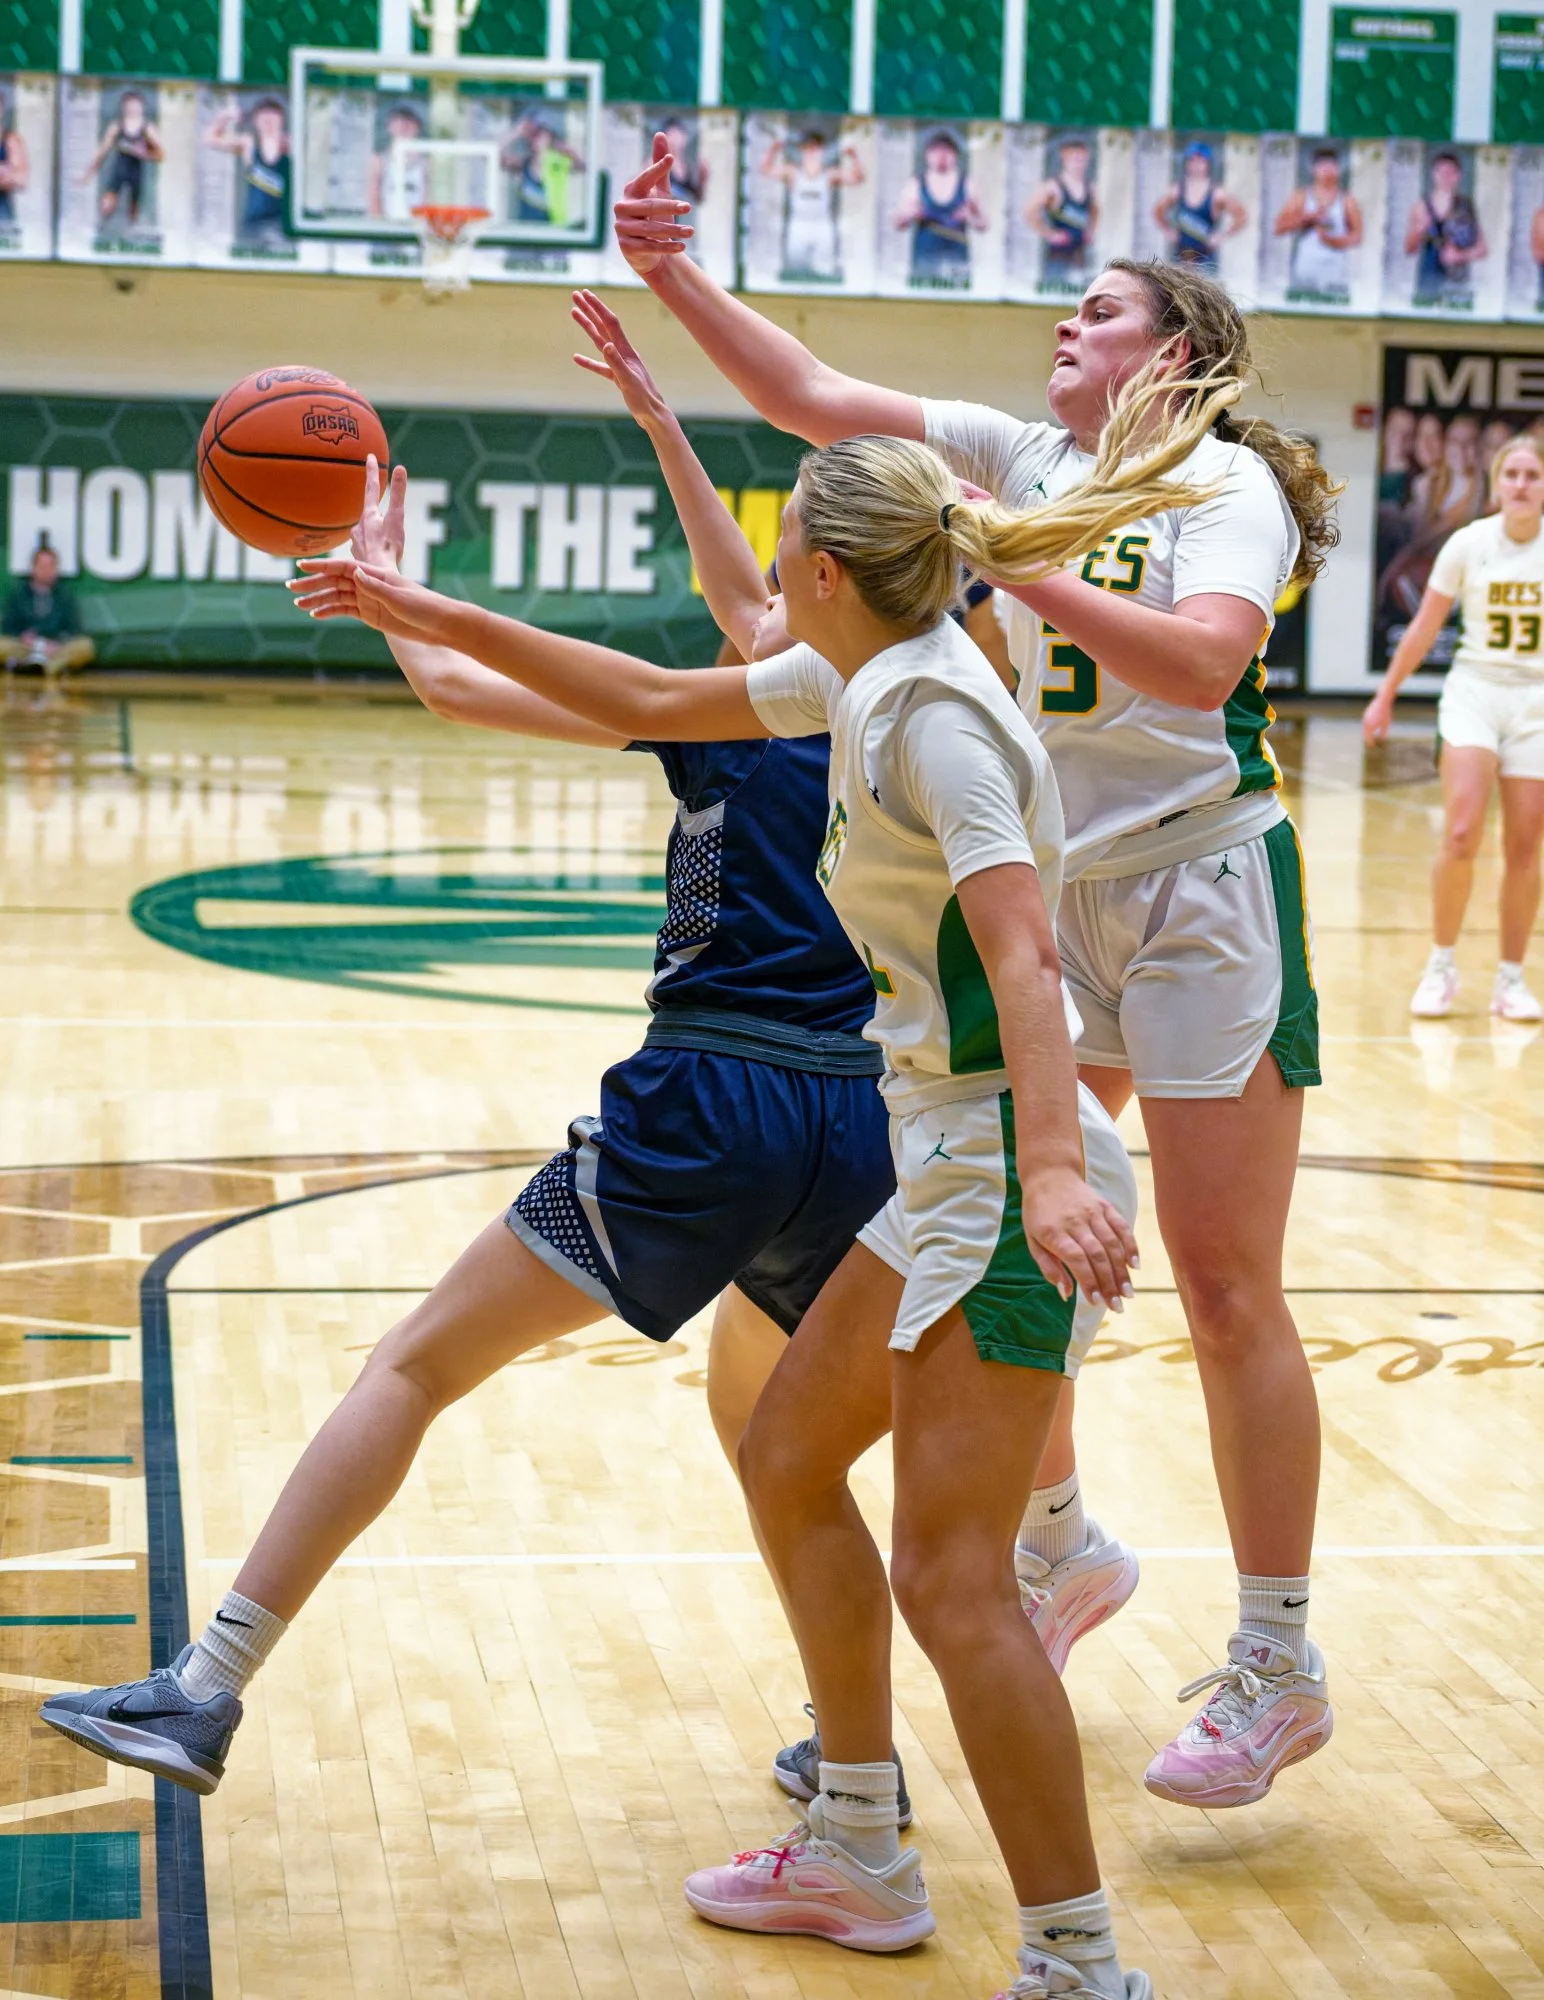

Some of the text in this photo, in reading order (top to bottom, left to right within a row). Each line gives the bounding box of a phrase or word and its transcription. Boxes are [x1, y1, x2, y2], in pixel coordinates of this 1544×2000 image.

[305, 414, 358, 436] OHSAA
[477, 480, 657, 593] THE
[1488, 582, 1541, 606] BEES
[1487, 612, 1541, 653] 33
